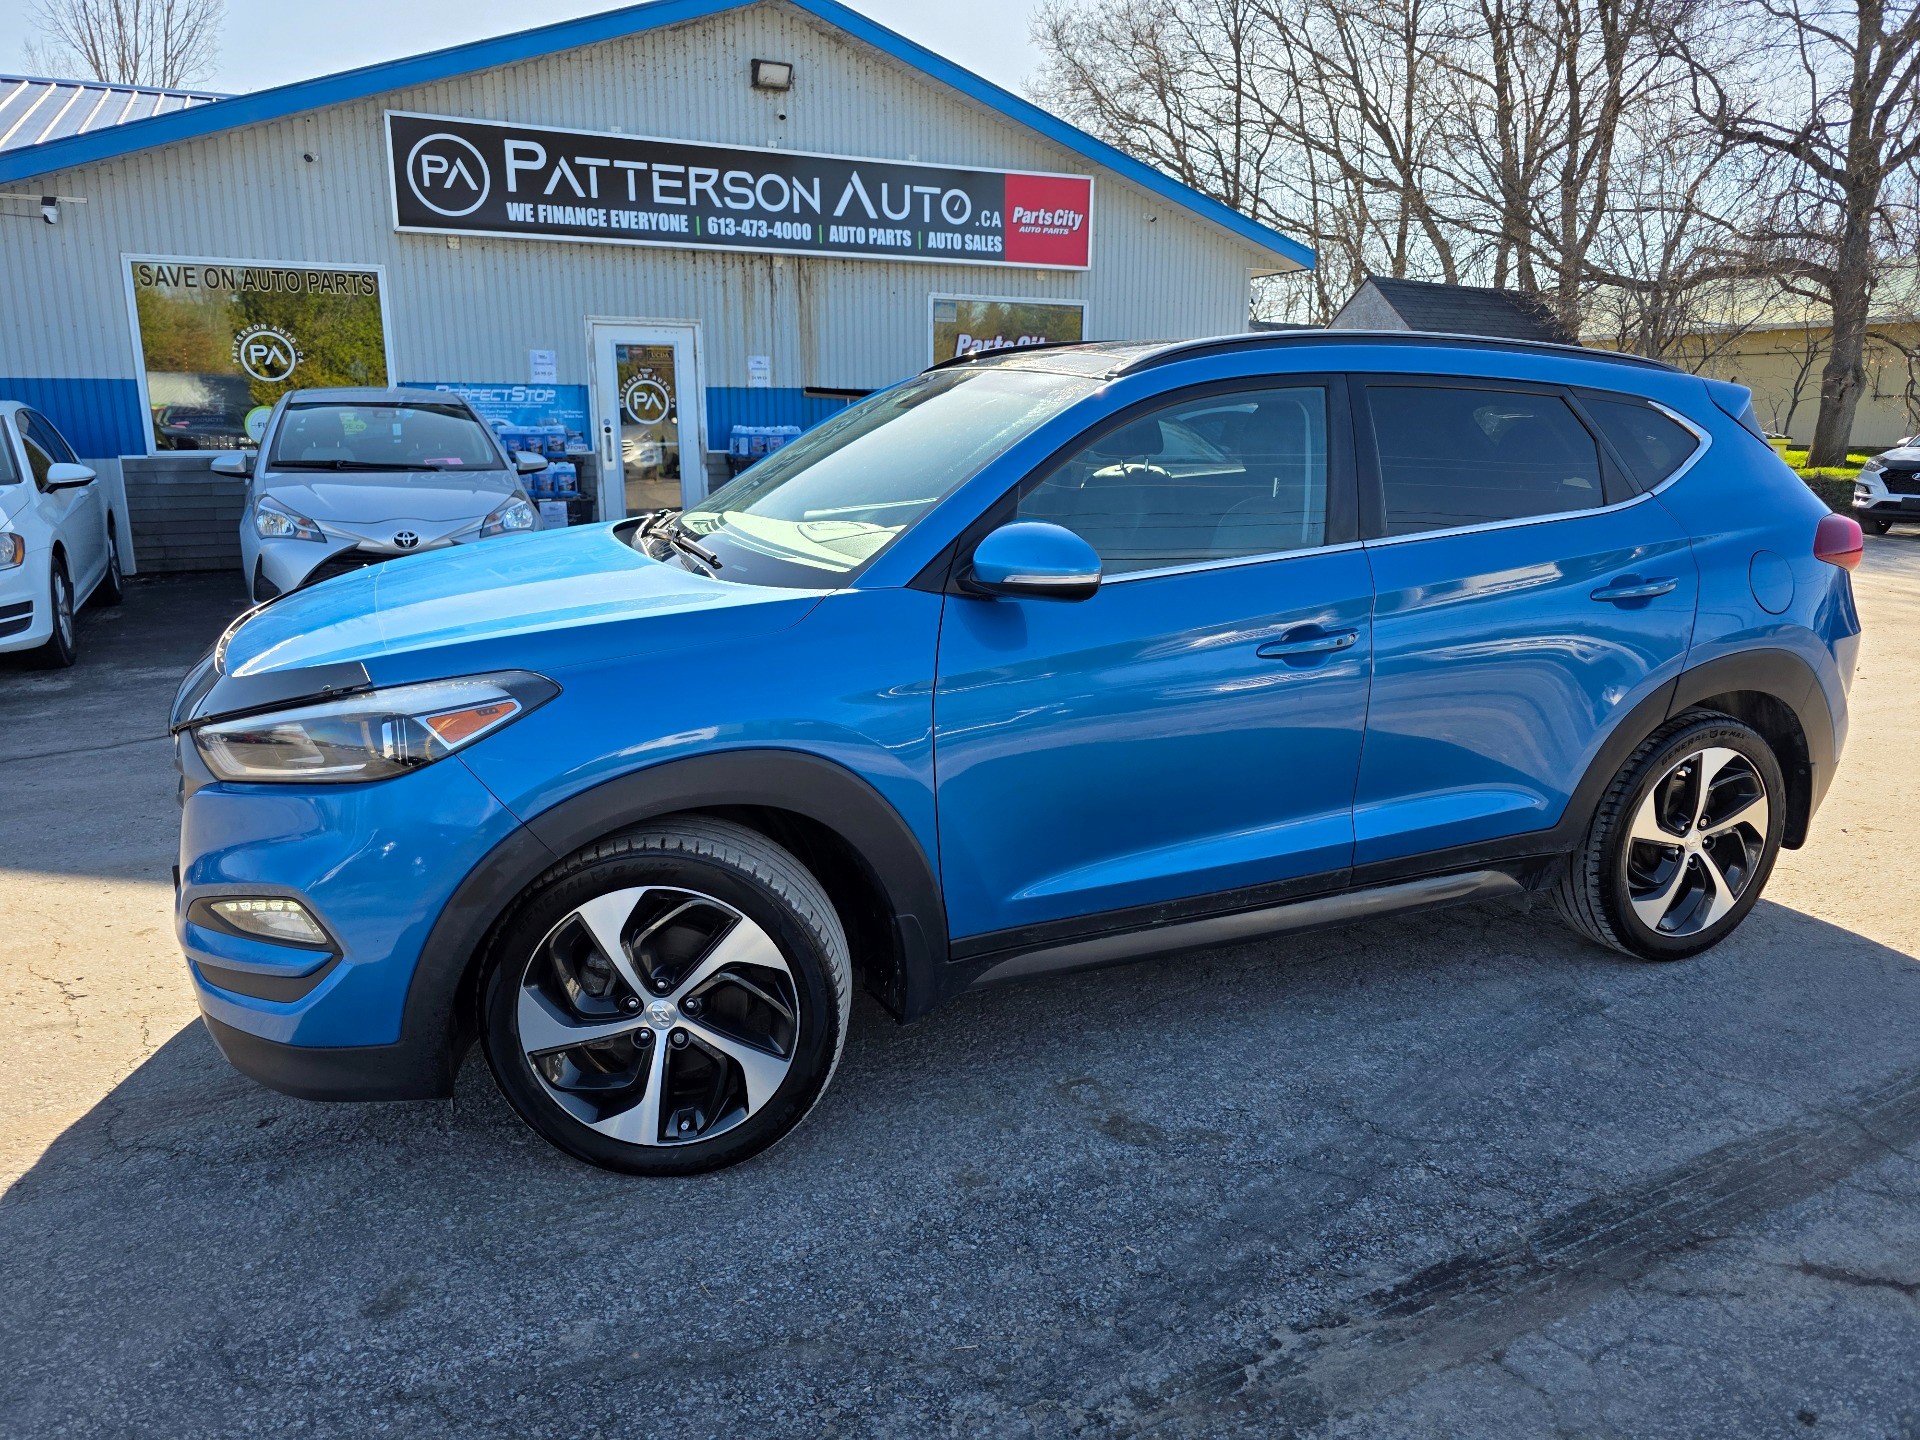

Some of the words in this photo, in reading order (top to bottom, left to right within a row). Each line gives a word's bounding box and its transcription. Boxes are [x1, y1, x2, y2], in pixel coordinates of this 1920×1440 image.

[421, 154, 479, 191] PA
[504, 138, 821, 215] PATTERSON
[506, 201, 535, 223] WE
[538, 203, 608, 228] FINANCE
[610, 208, 689, 233] EVERYONE
[707, 216, 812, 241] 613-473-4000
[829, 225, 866, 245] AUTO
[869, 226, 912, 247] PARTS
[928, 231, 962, 251] AUTO
[965, 233, 1003, 253] SALES
[1019, 226, 1041, 234] AUTO
[1043, 227, 1069, 235] PARTS
[138, 264, 198, 288] SAVE
[204, 267, 236, 291] ON
[242, 269, 301, 293] AUTO
[307, 271, 376, 297] PARTS
[231, 323, 267, 364] PATTERSON
[249, 344, 288, 365] PA
[619, 373, 649, 408] PATTERSON
[633, 391, 663, 410] PA
